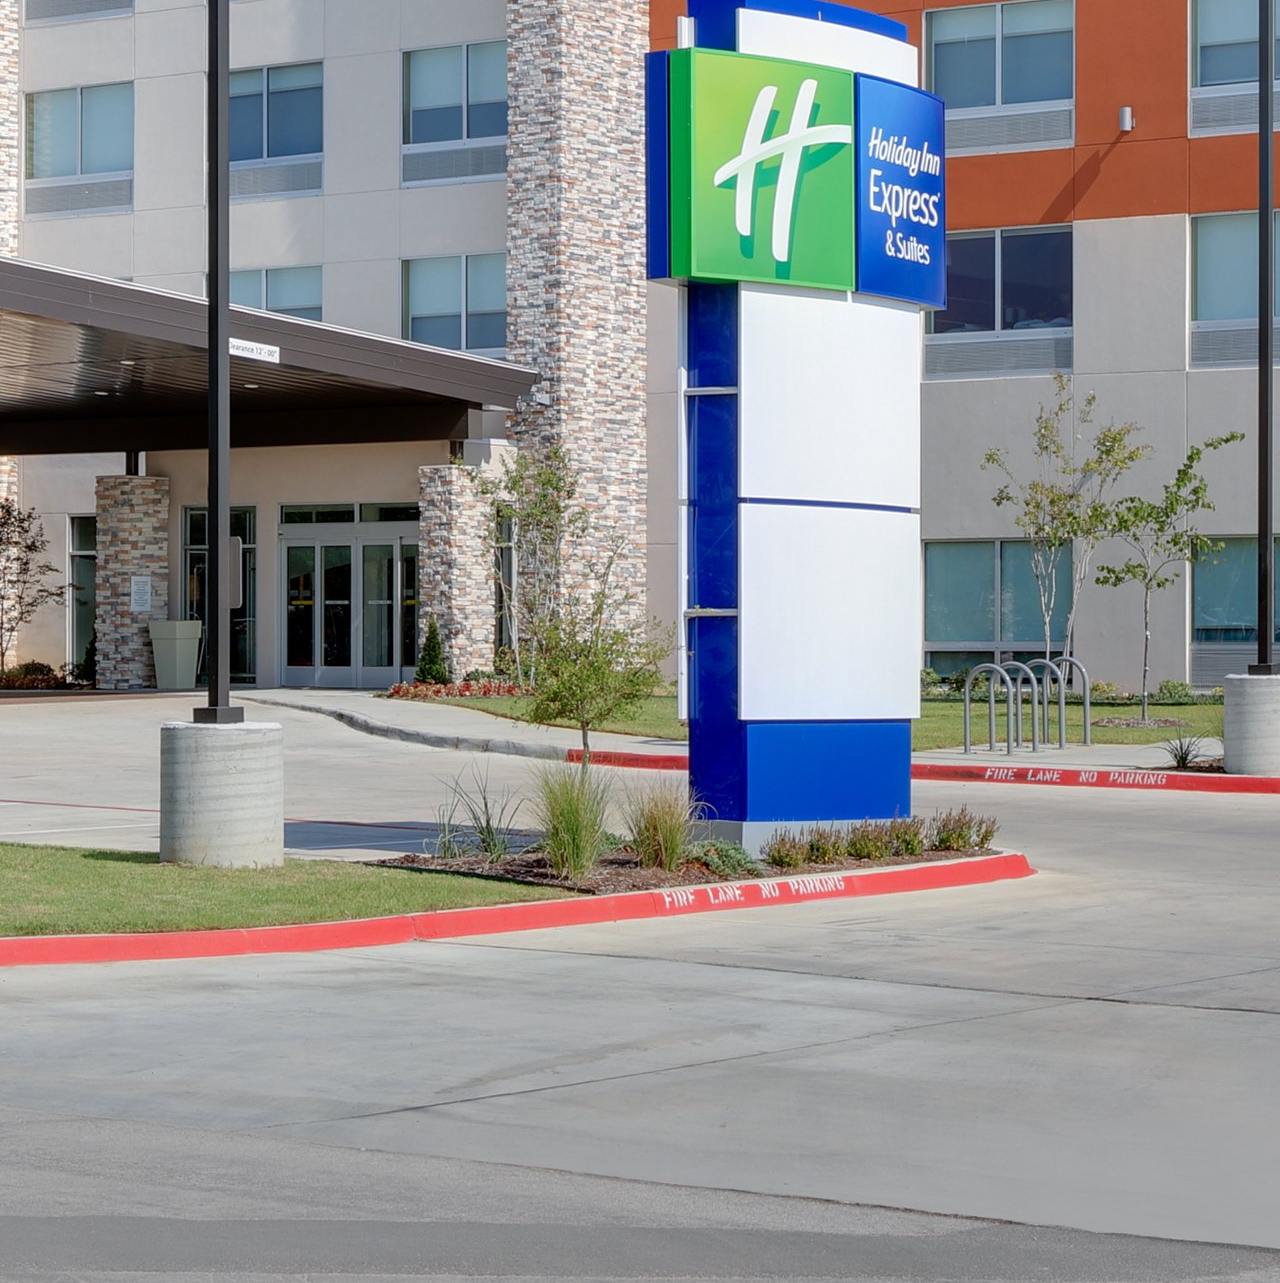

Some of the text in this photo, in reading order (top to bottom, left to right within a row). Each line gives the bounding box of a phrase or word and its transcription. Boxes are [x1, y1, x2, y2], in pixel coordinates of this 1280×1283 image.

[868, 126, 940, 177] Holiday Inn
[869, 168, 939, 228] Express
[886, 230, 930, 265] & Suites
[230, 342, 254, 353] learance
[984, 768, 1167, 785] FIRE LANE NO PARKING
[662, 876, 845, 909] FIRE LANE NO PARKING
